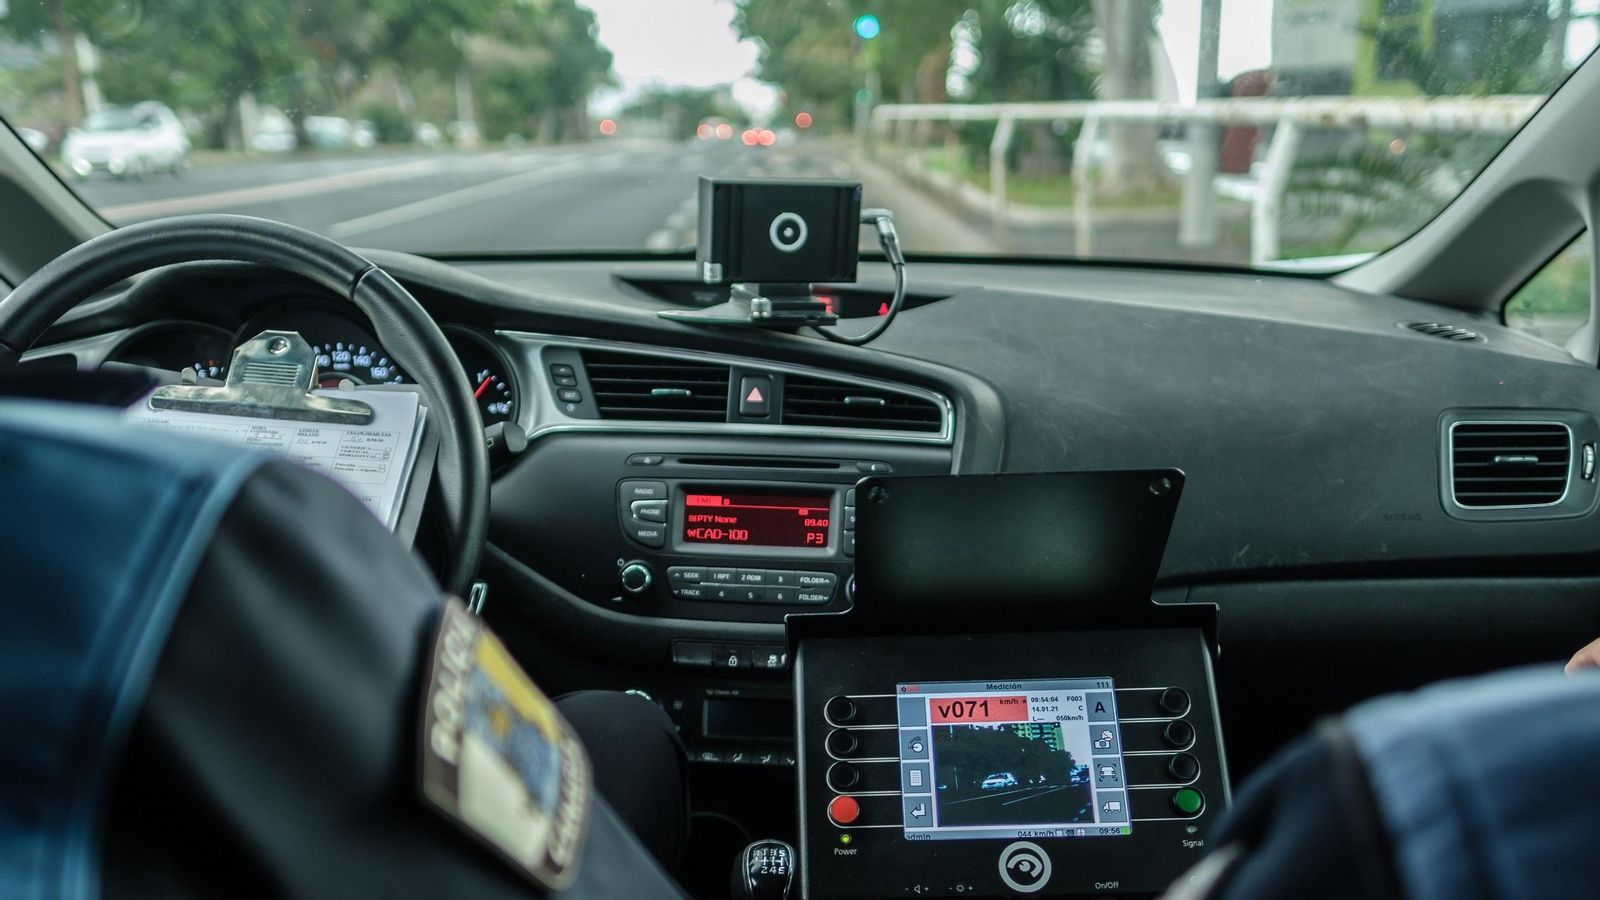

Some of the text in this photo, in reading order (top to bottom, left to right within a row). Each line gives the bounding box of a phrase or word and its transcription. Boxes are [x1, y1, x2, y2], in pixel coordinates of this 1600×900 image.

[332, 350, 351, 362] 120
[352, 354, 371, 367] 140
[715, 515, 737, 524] None
[696, 528, 748, 540] CAD-100
[806, 532, 824, 544] P3
[986, 682, 1022, 690] Medición
[938, 700, 990, 718] v071
[1094, 702, 1106, 713] A
[1182, 840, 1204, 848] Signal
